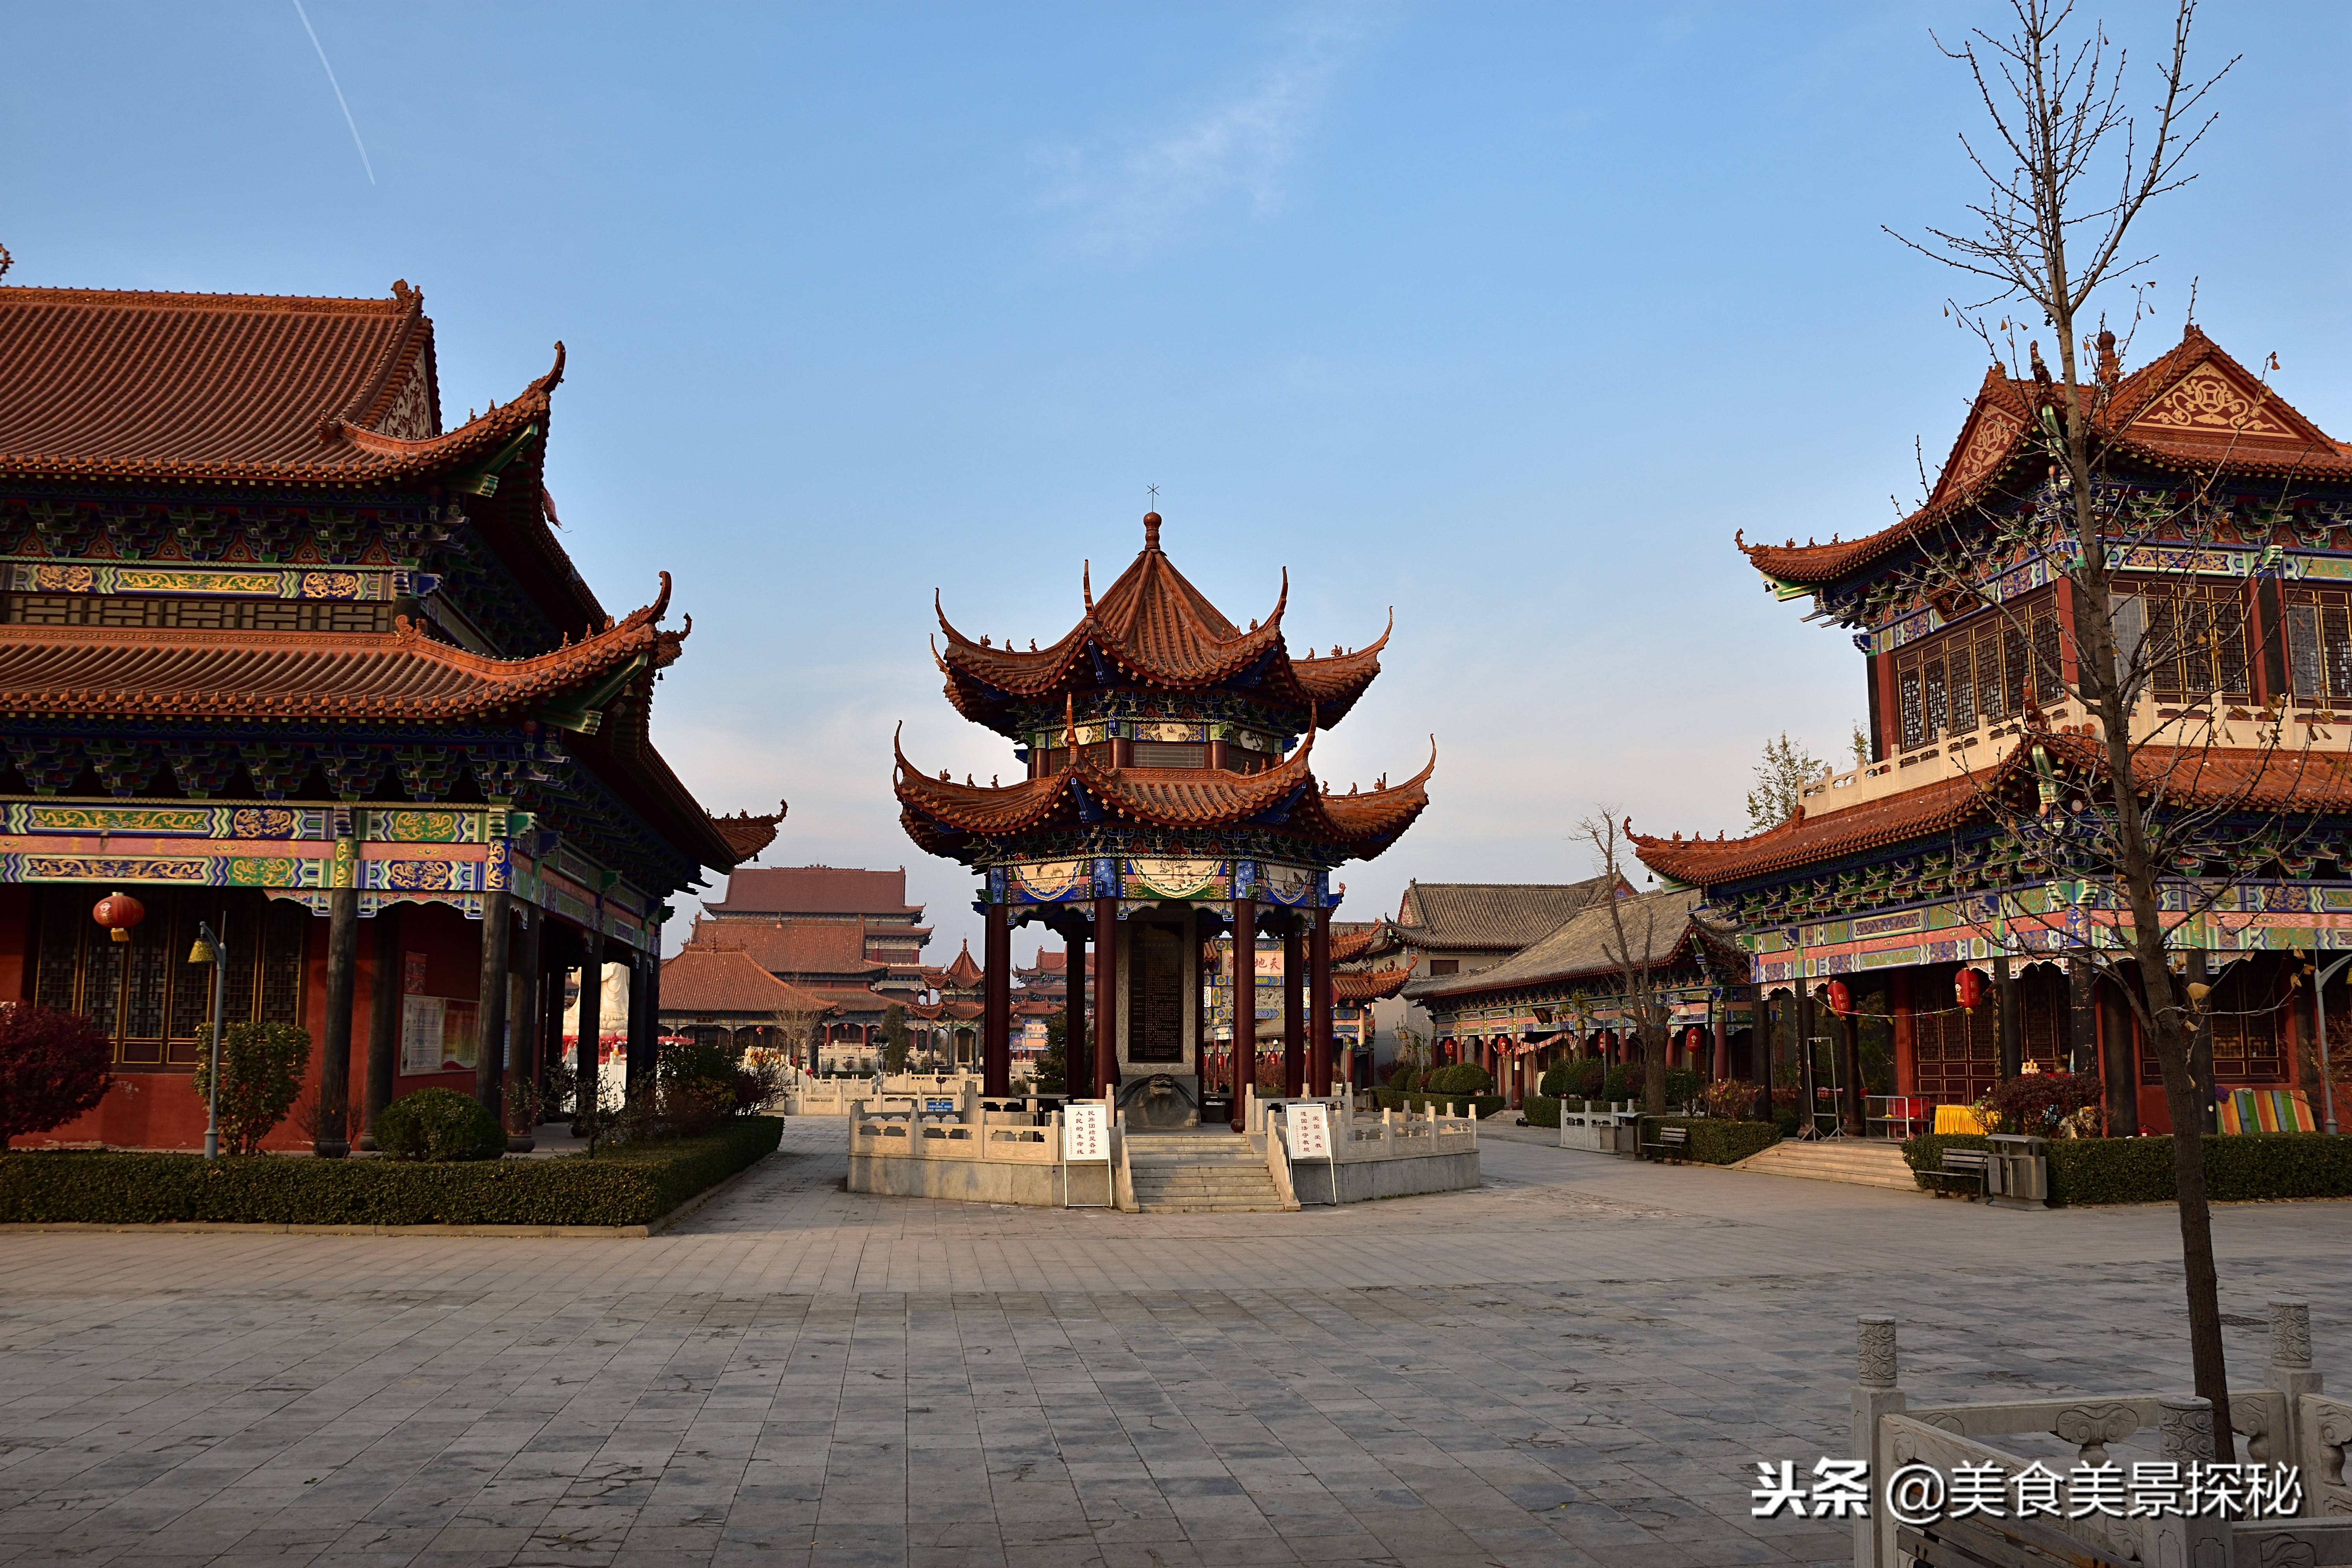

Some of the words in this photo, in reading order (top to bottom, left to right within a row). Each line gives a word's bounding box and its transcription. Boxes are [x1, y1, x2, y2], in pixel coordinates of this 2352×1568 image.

[1076, 1111, 1084, 1154] 人民的生命线
[1088, 1111, 1096, 1154] 民族团结是各族
[1300, 1111, 1310, 1152] 遵国法守教规
